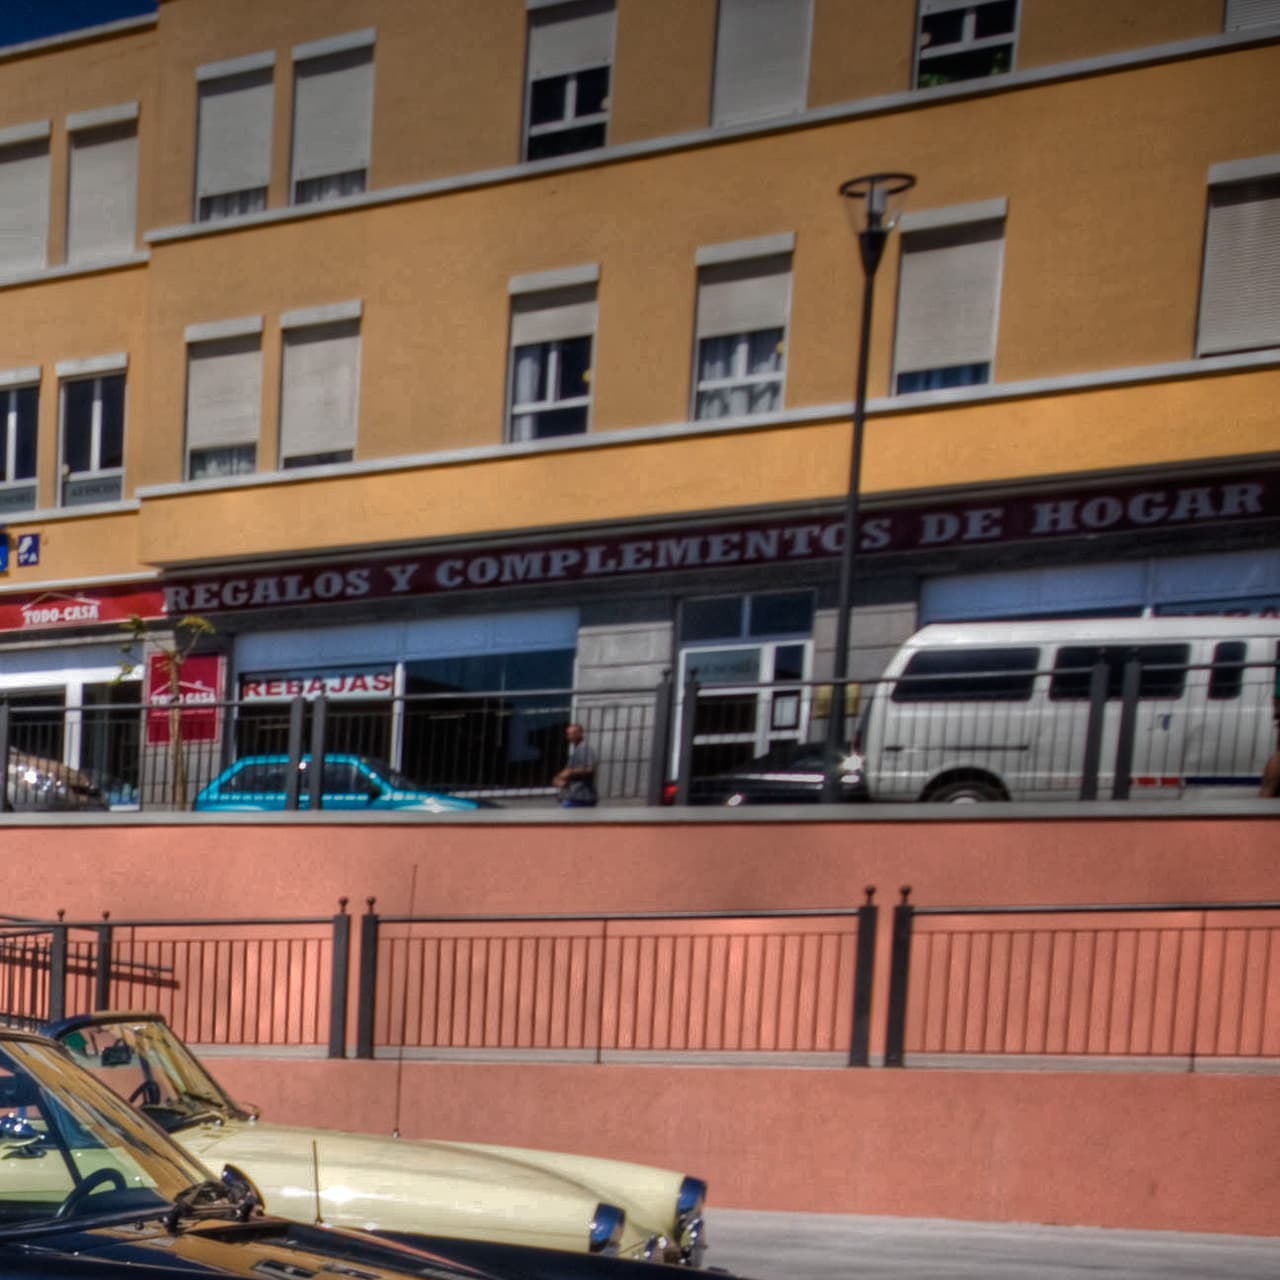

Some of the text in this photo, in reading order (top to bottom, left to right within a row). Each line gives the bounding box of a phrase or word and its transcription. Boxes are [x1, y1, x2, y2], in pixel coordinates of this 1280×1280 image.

[163, 482, 1265, 612] REGALOS Y COMPLEMENTOS DE HOGAR
[23, 605, 99, 624] TODO-CASA
[244, 673, 392, 698] REBAJAS
